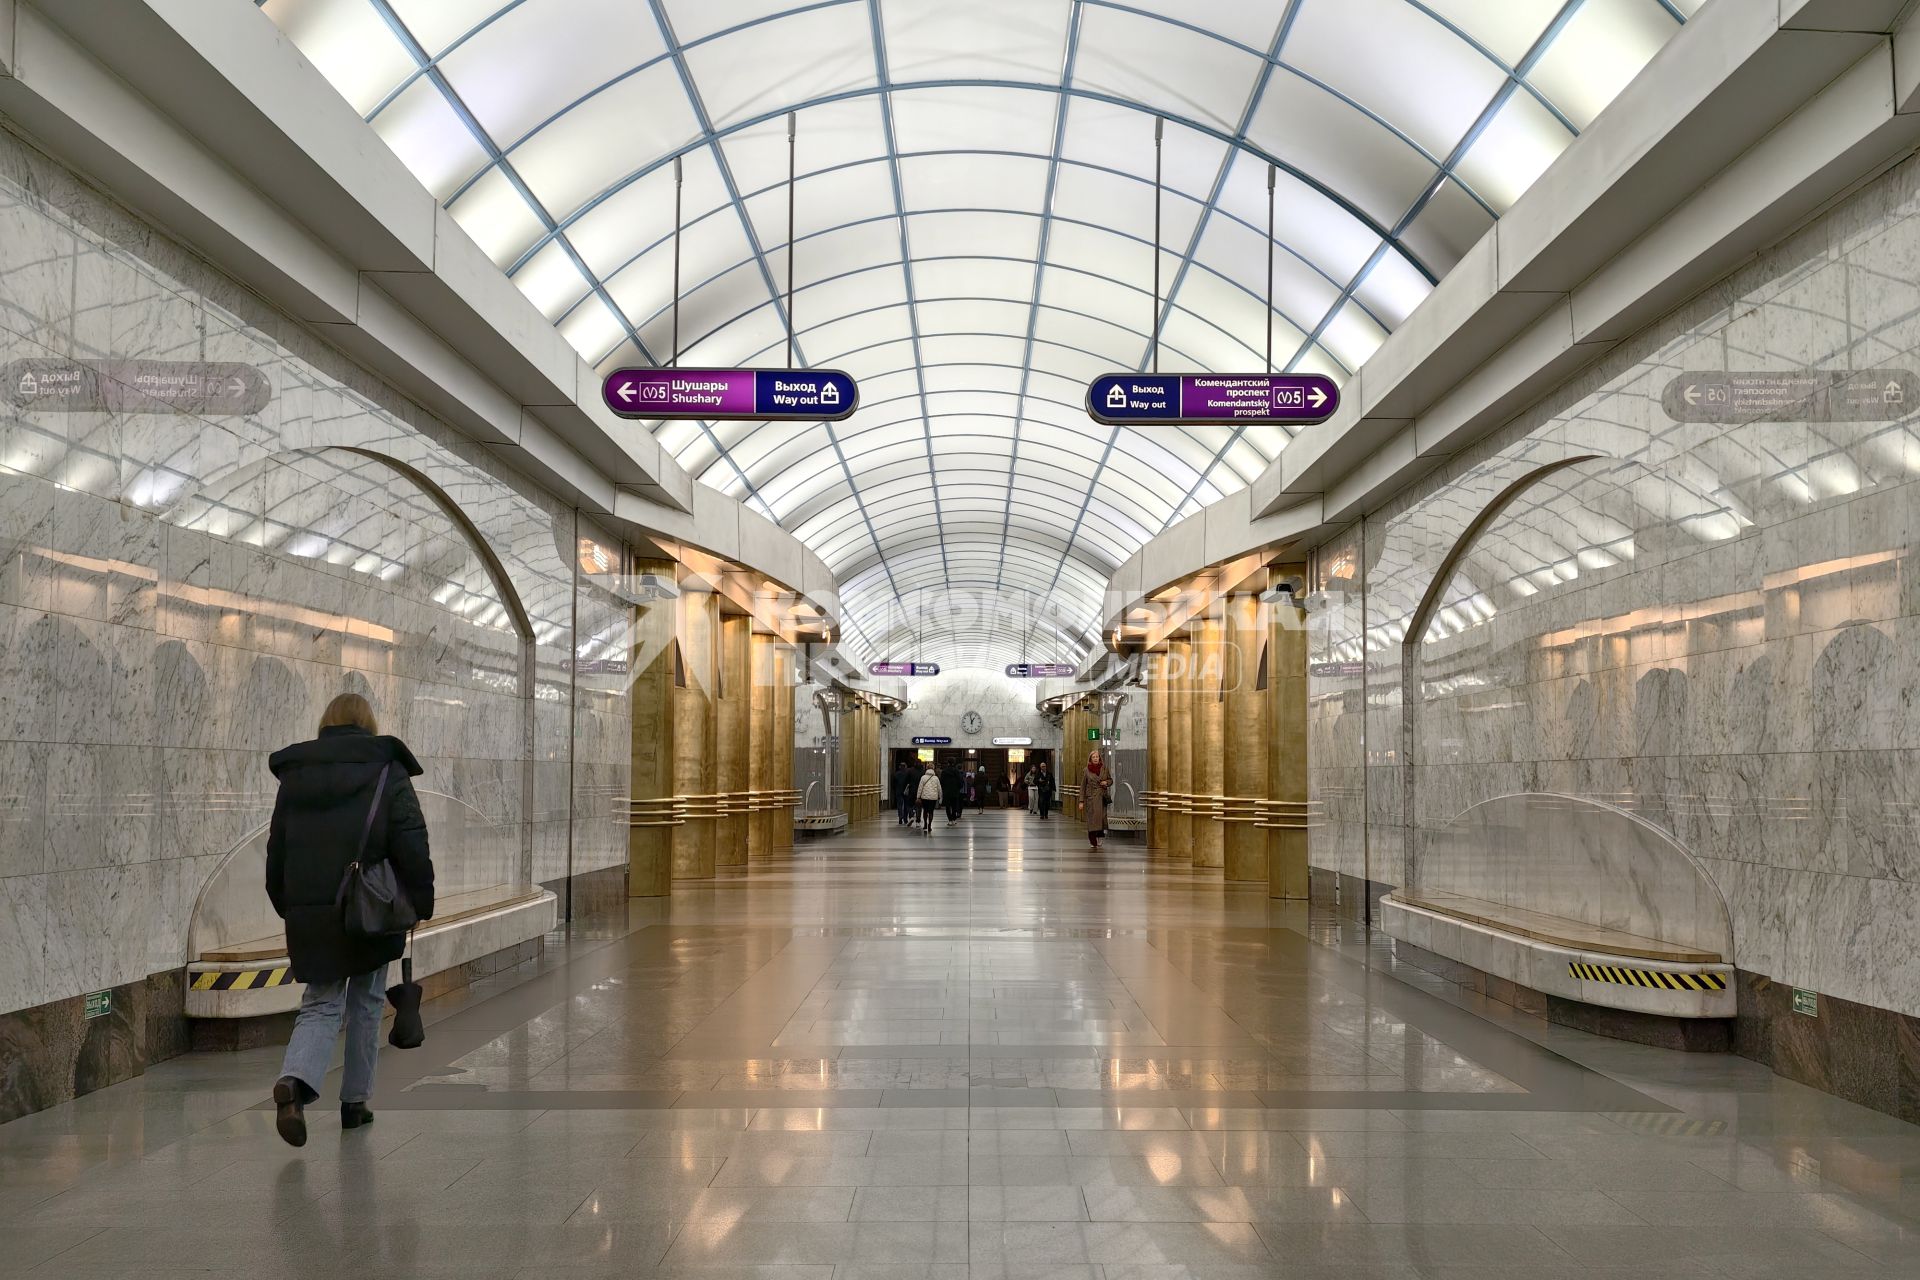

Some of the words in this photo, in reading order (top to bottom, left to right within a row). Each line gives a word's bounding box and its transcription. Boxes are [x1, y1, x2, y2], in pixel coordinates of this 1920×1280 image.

[671, 379, 729, 393] Шушары
[775, 380, 817, 394] Выход
[1194, 378, 1270, 388] Комендантский
[1132, 384, 1165, 395] Выход
[1226, 388, 1270, 398] проспект
[672, 393, 722, 406] Shushary
[773, 394, 798, 406] Way
[799, 395, 819, 405] out
[1207, 399, 1270, 409] Komendantskiy
[1130, 400, 1150, 410] Way
[1151, 401, 1167, 409] out
[1233, 407, 1270, 417] prospekt
